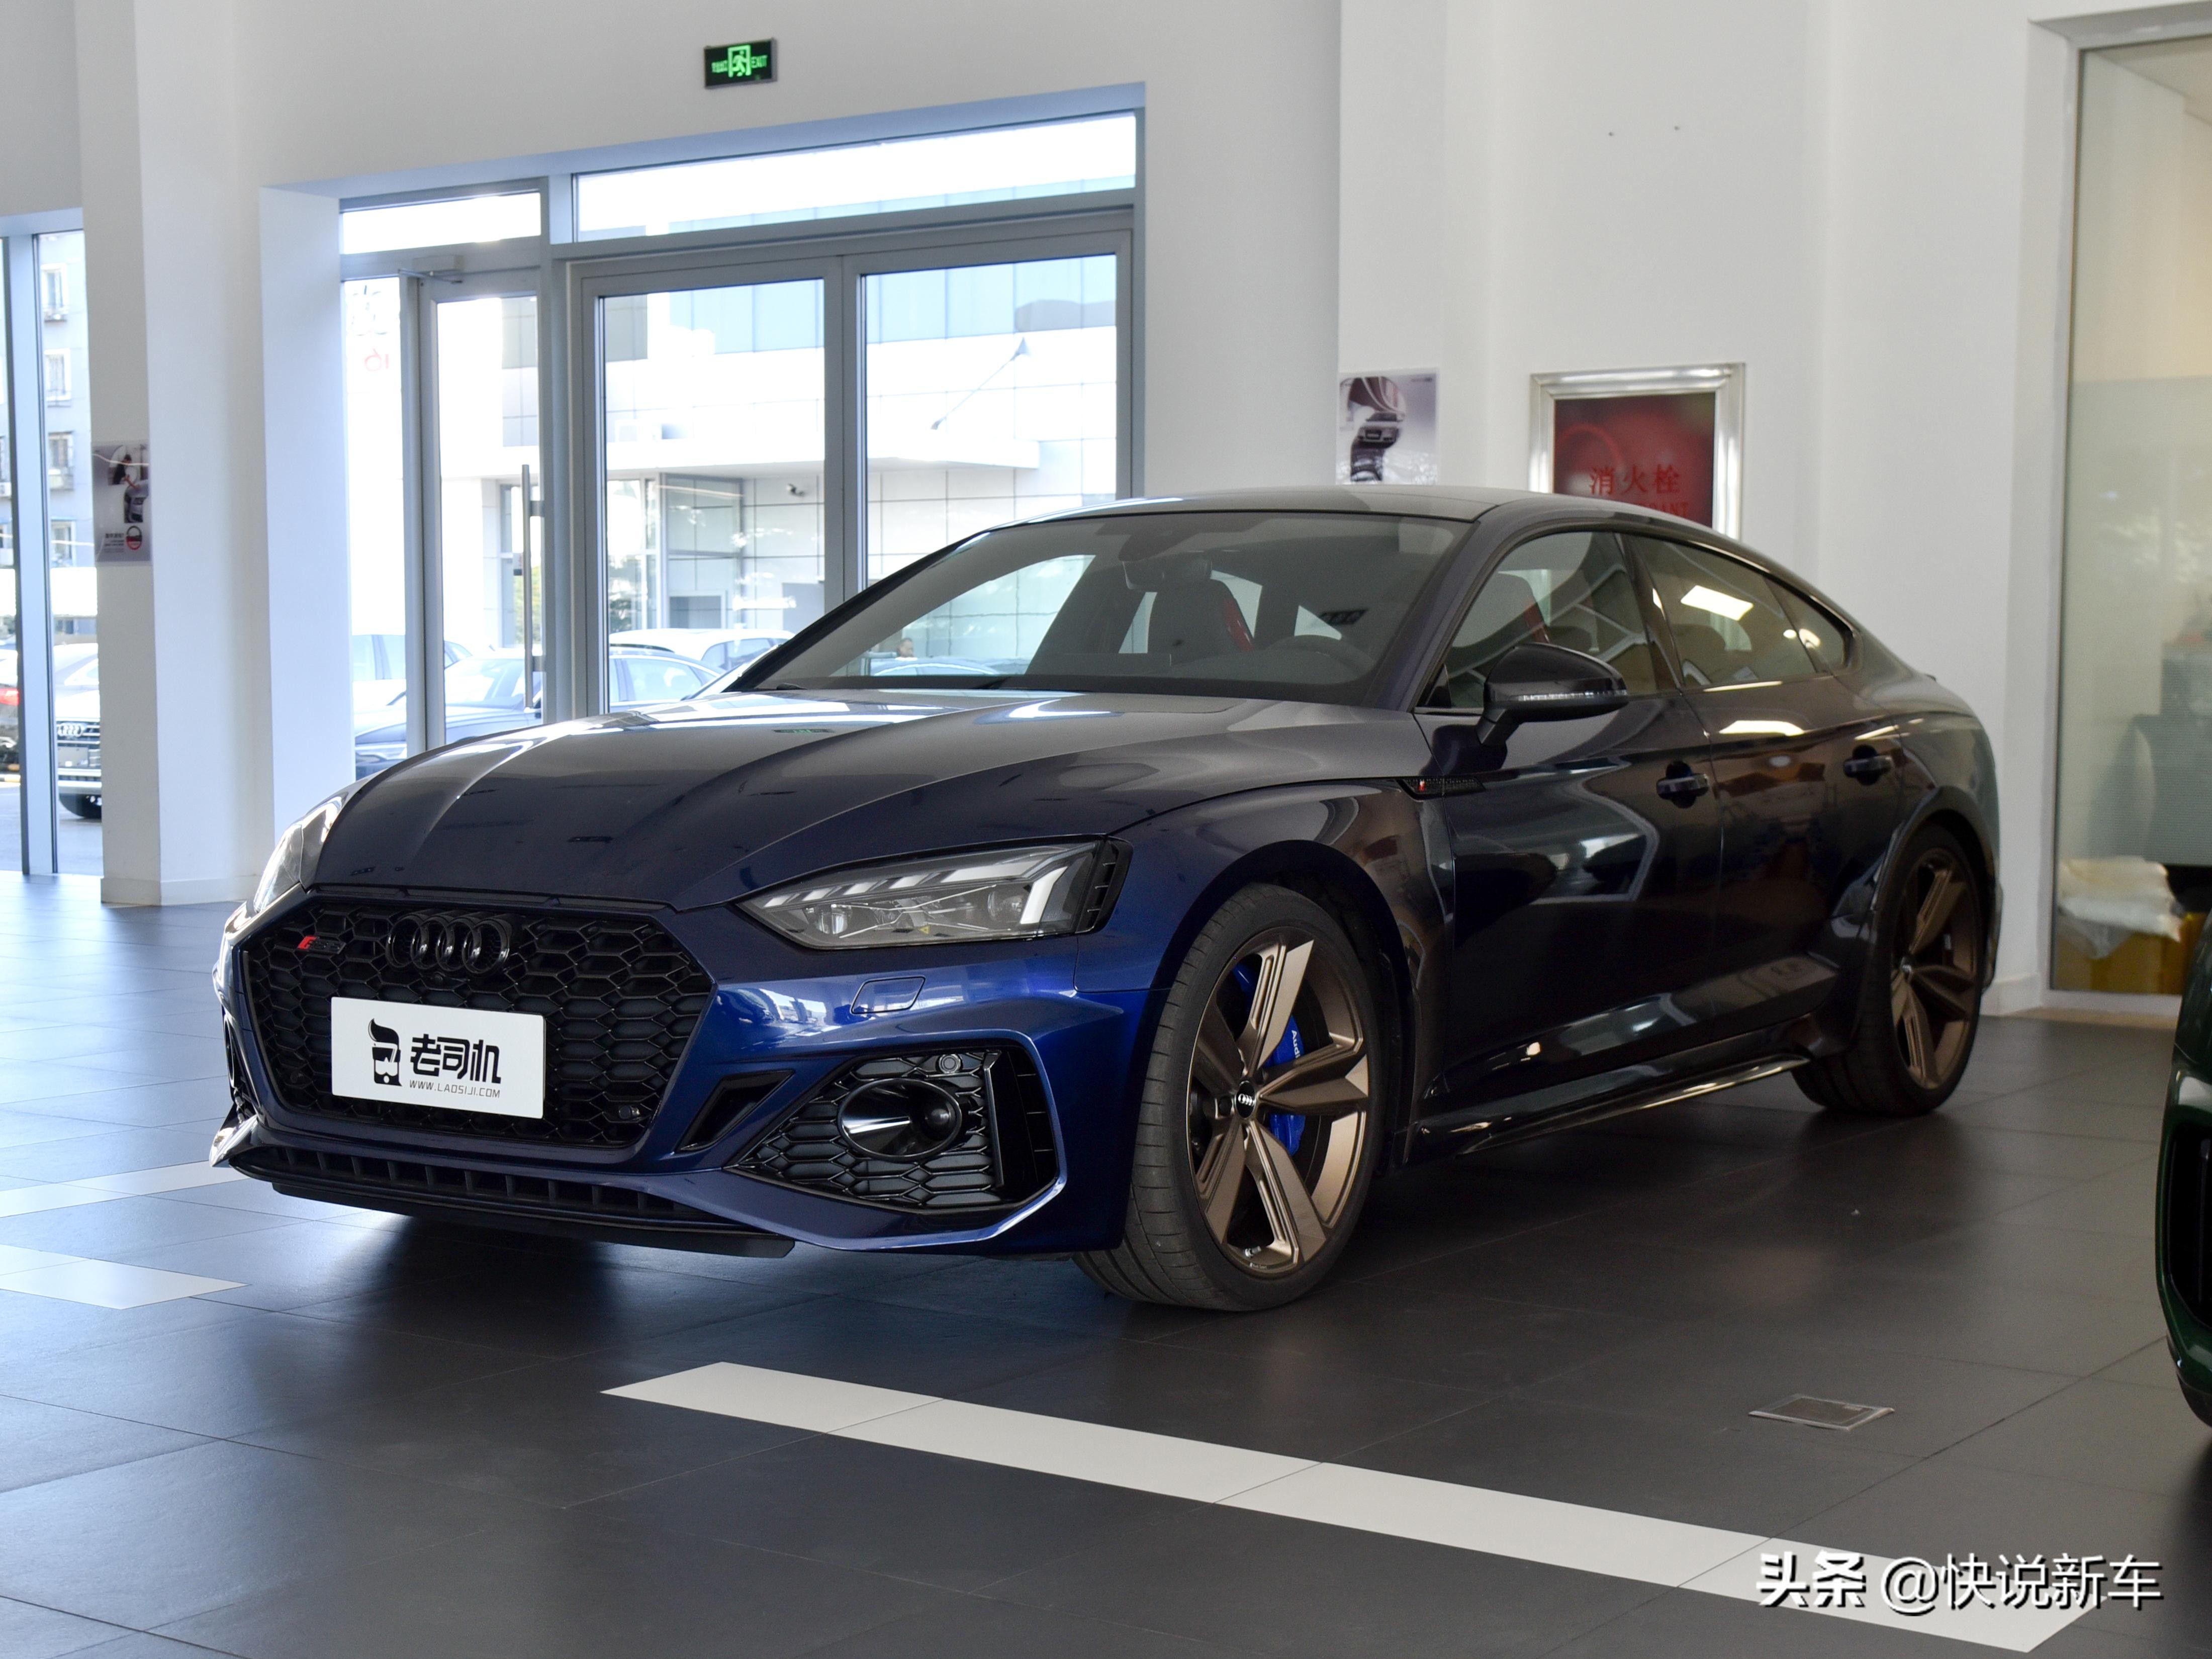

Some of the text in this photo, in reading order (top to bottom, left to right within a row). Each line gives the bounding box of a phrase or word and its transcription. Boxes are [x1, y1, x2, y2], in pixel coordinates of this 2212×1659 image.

[1590, 464, 1681, 495] 消火栓
[1292, 1030, 1301, 1058] Audi
[410, 1034, 502, 1084] 老司机
[409, 1079, 500, 1098] WWW.LAOSIJI.COM
